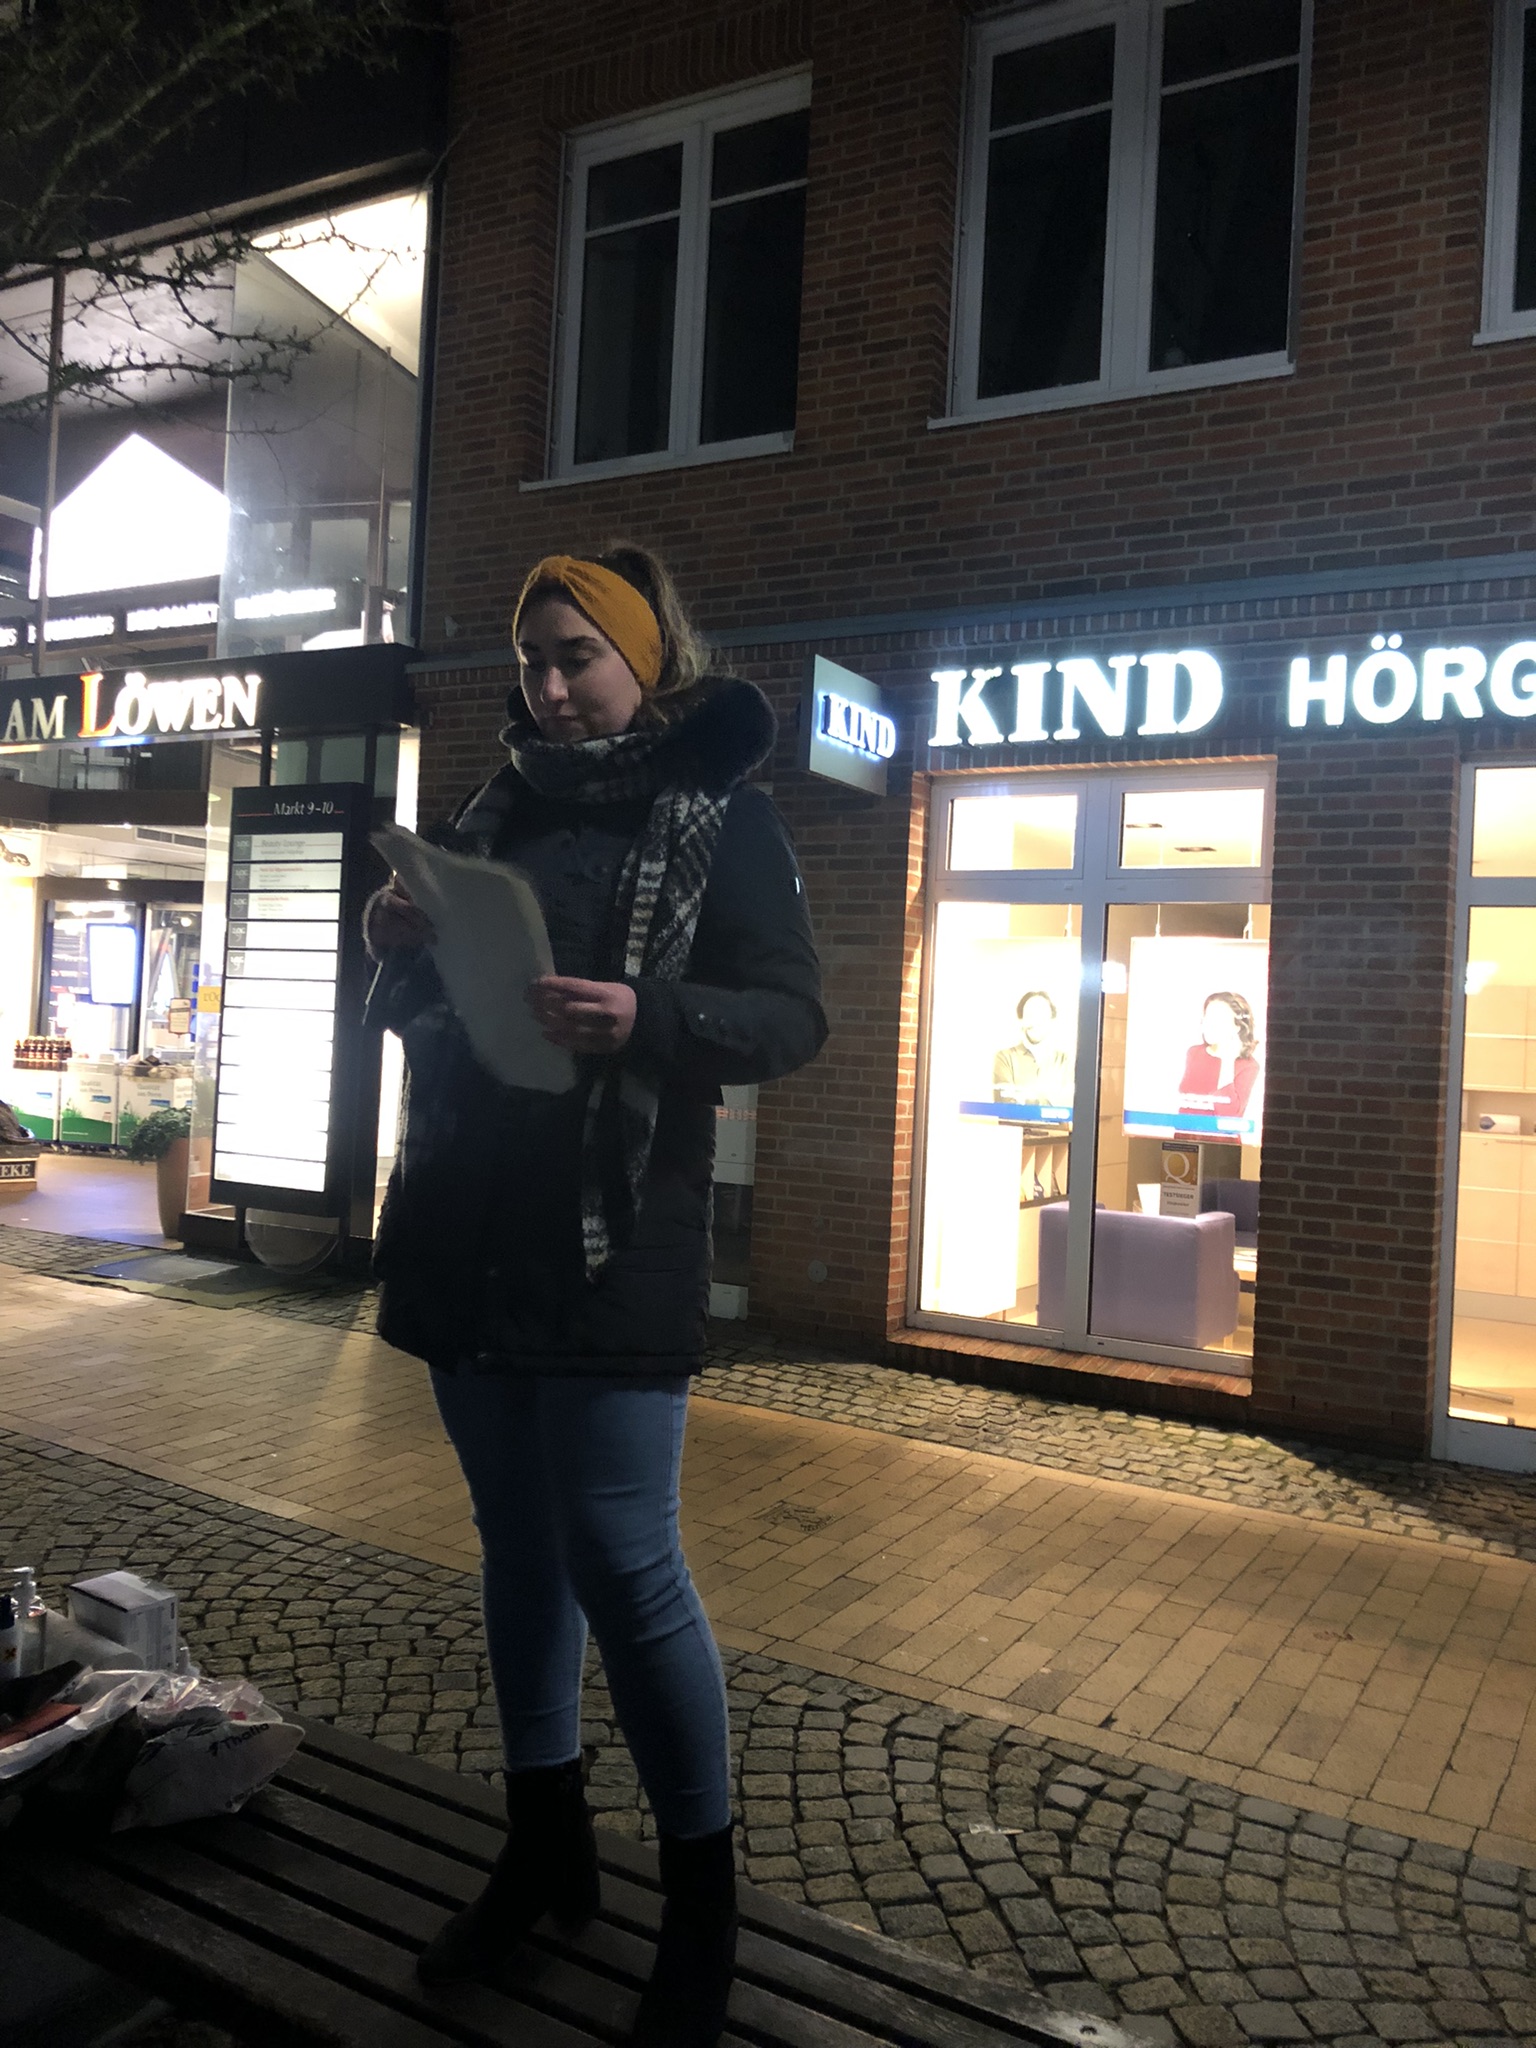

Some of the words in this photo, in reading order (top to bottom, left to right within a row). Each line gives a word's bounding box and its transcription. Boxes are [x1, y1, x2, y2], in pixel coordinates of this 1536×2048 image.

[3, 695, 68, 741] AM
[78, 672, 262, 737] LÖWEN
[928, 650, 1223, 746] KIND
[1289, 634, 1536, 727] HÖRG
[820, 691, 897, 759] KIND
[273, 800, 304, 815] Markt
[0, 1163, 31, 1178] EKE
[1163, 1151, 1191, 1186] Q
[221, 1722, 270, 1750] Thalia
